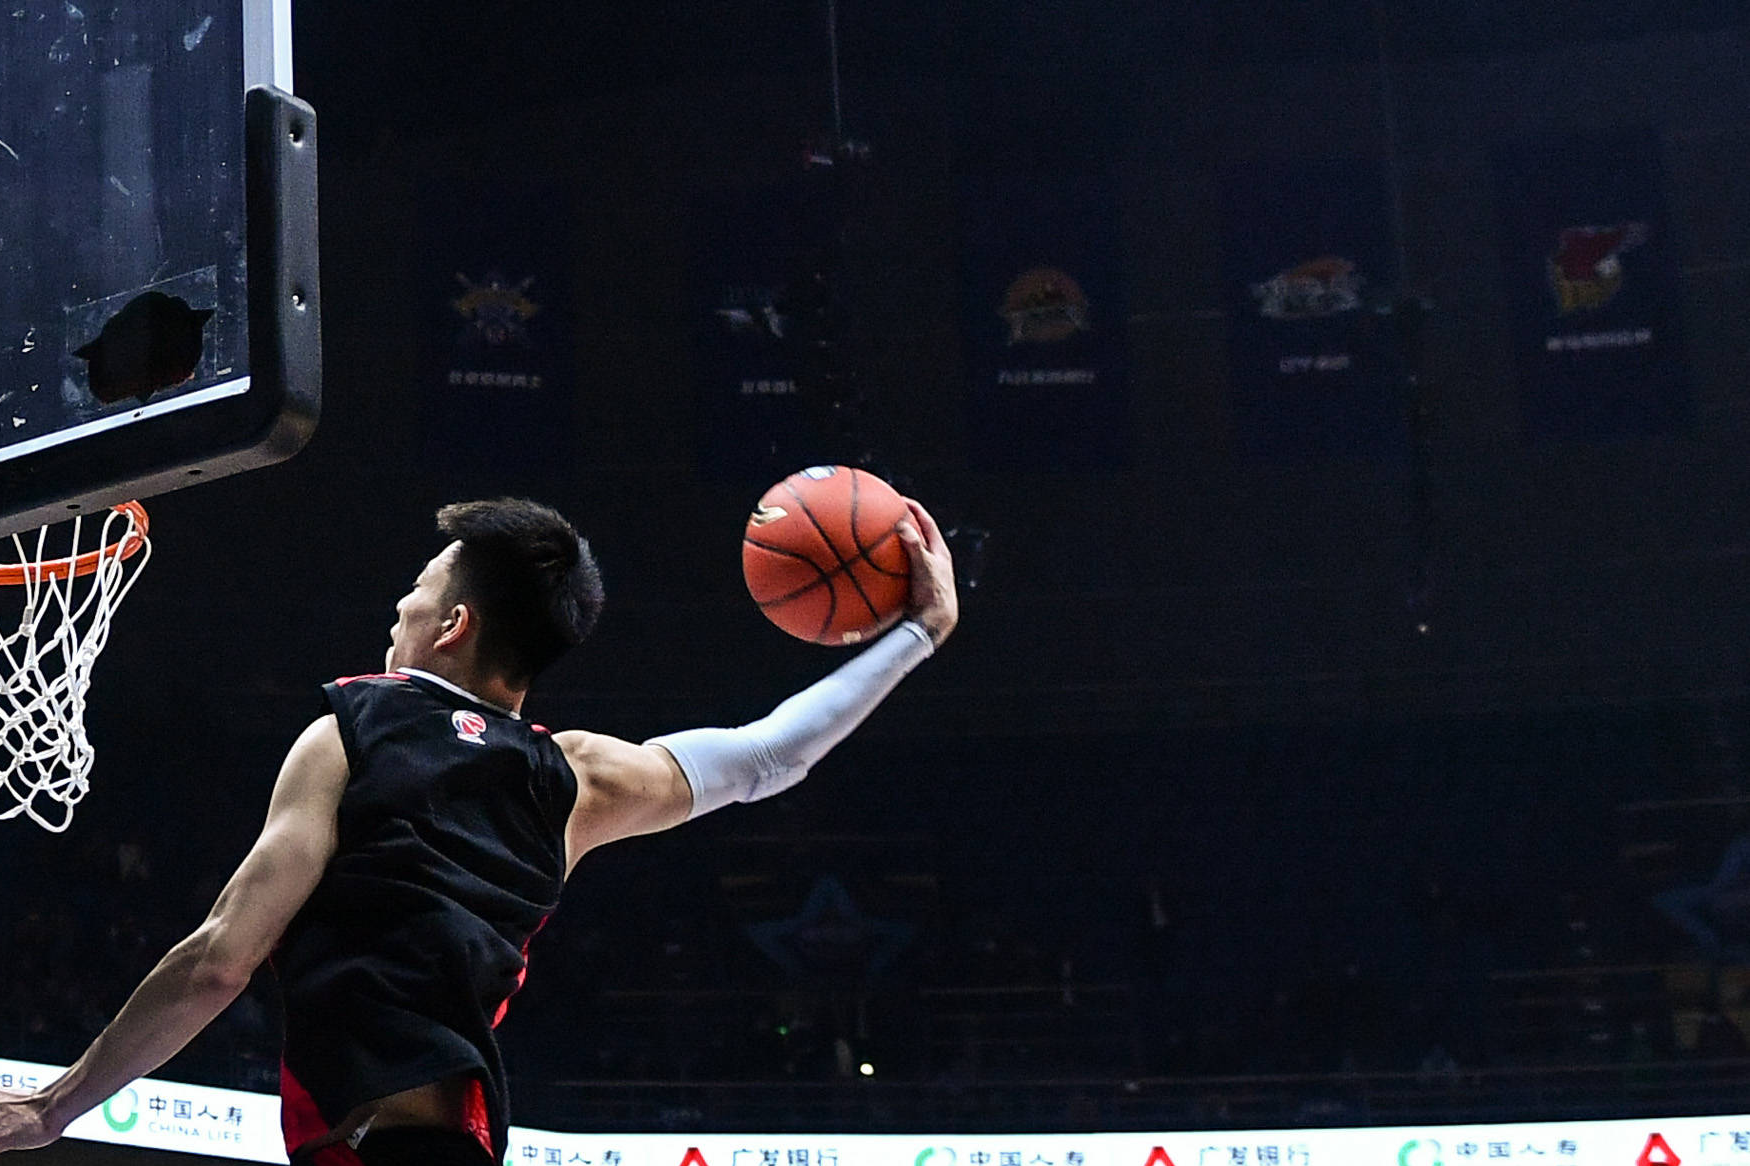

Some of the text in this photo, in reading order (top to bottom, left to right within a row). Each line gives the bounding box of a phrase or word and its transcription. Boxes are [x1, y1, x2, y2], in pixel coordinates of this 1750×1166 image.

[149, 1096, 243, 1126] 中国人寿
[148, 1121, 243, 1143] CHINA LIFE
[1456, 1139, 1578, 1157] 中国人寿
